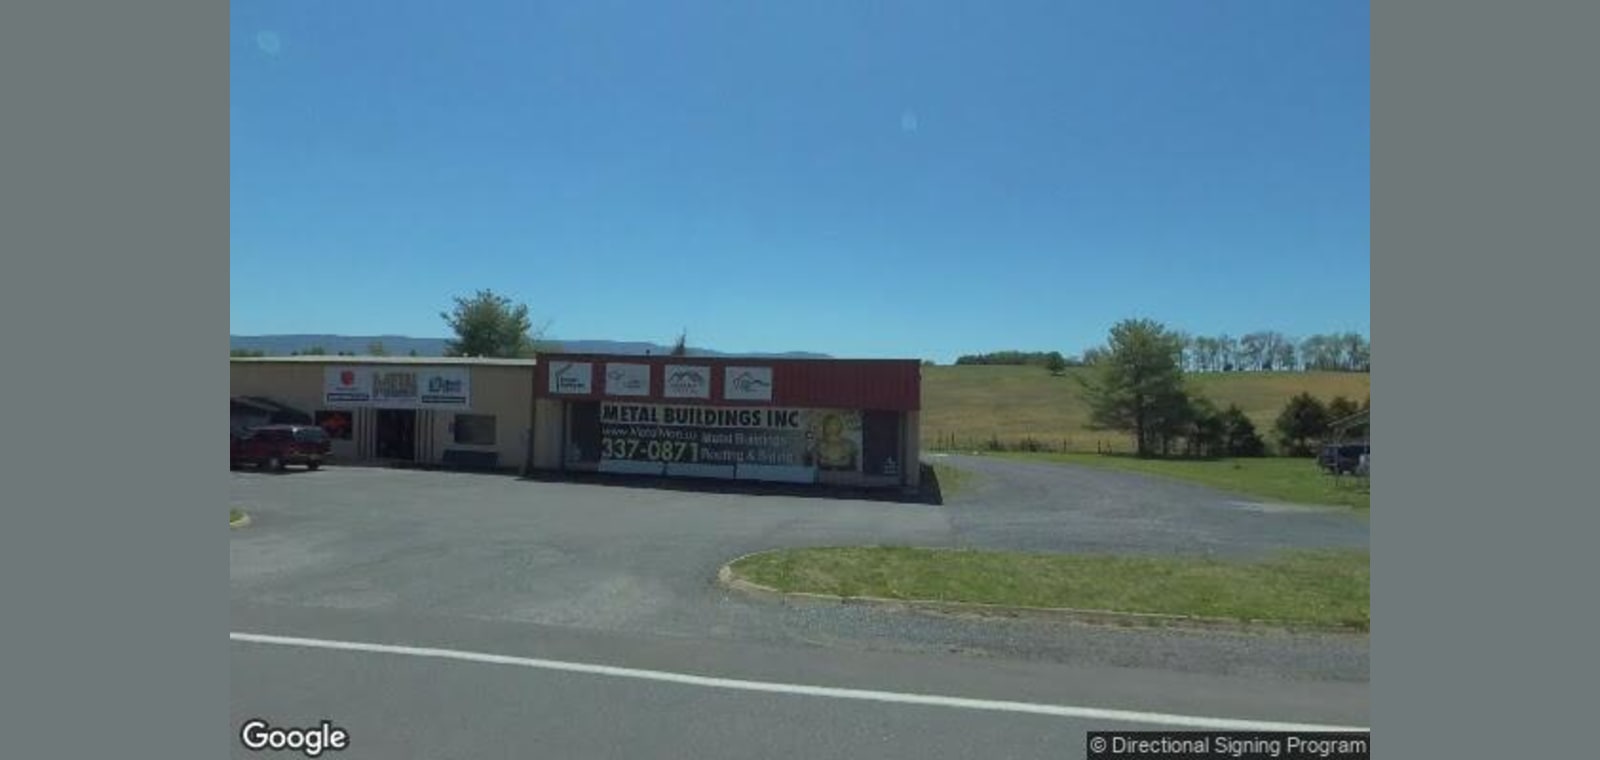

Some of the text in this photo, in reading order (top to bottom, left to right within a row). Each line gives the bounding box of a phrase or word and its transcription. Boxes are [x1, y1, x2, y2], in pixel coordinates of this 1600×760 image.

[602, 405, 799, 427] METAL BUILDINGS INC
[601, 438, 699, 462] 337-0871
